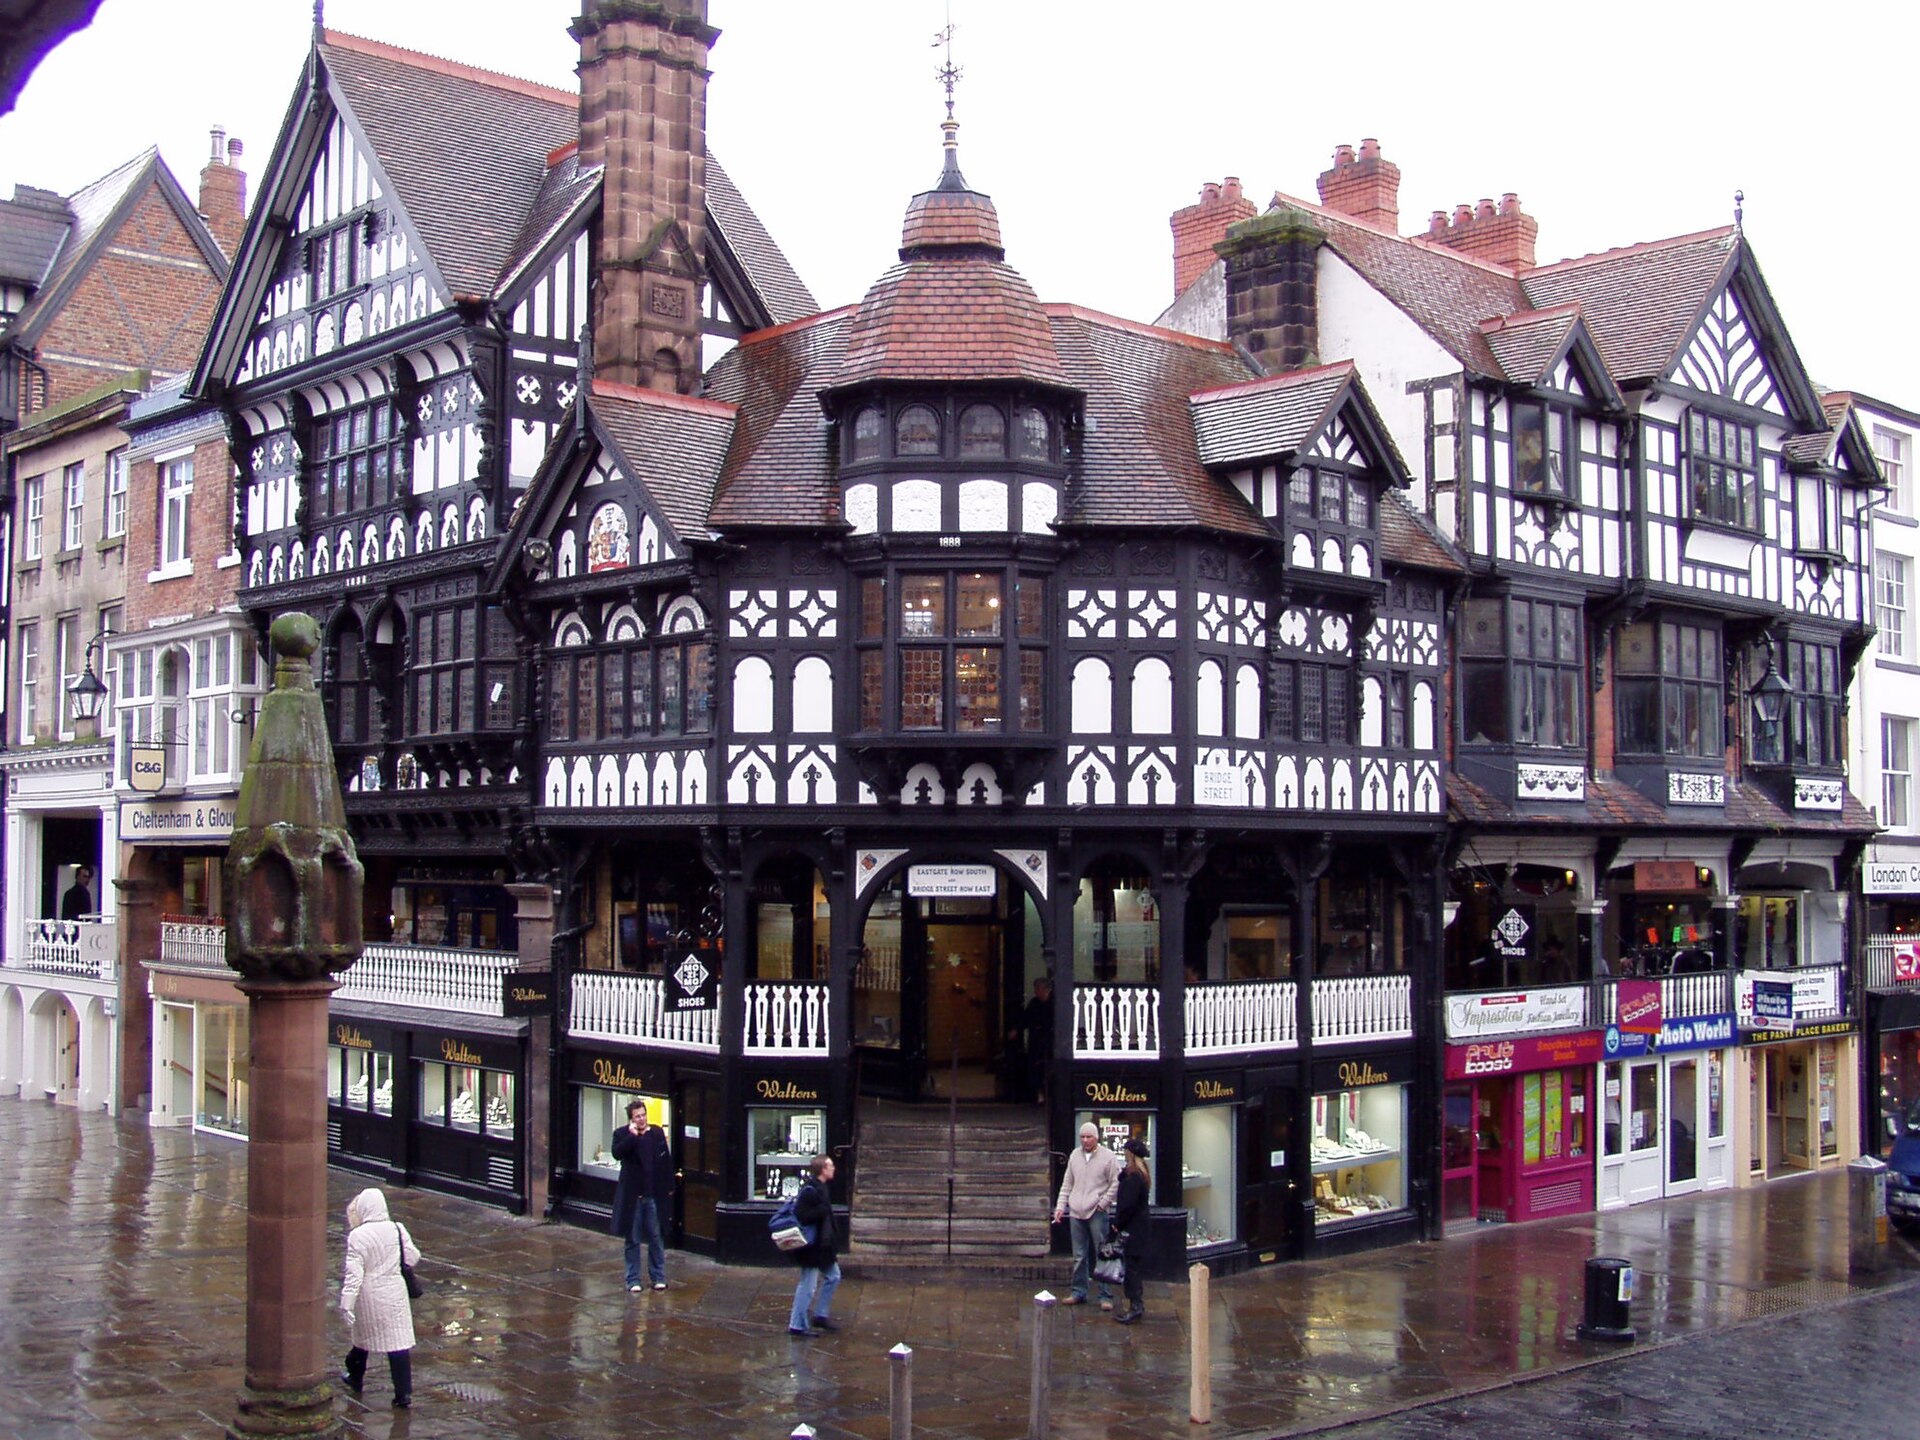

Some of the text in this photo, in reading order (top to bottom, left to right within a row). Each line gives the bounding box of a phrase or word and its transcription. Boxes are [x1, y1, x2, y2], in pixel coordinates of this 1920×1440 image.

[940, 536, 961, 548] 1888
[134, 761, 162, 775] C&G
[1203, 771, 1232, 784] BRIDGE
[1203, 787, 1233, 800] STREET
[132, 810, 192, 829] Cheltenham
[195, 808, 205, 828] &
[917, 868, 988, 876] EASTGATE ROW SOUTH
[1871, 866, 1907, 883] London
[912, 885, 991, 893] BRIDGE STREET ROW EAST
[1501, 947, 1526, 956] SHOES
[512, 988, 547, 1001] Waltons
[677, 997, 705, 1007] SHOES
[1757, 993, 1787, 1005] Photo
[1756, 1003, 1787, 1015] World
[336, 1024, 372, 1049] Waltons
[1655, 1017, 1731, 1046] Photo World
[1752, 1023, 1851, 1042] THE PASTY PLACE BAKERY
[441, 1038, 482, 1065] Waltons
[593, 1059, 642, 1089] Waltons
[1338, 1062, 1388, 1087] Waltons
[756, 1080, 817, 1099] Waltons
[1086, 1083, 1147, 1102] Waltons
[1194, 1080, 1234, 1099] Waltons
